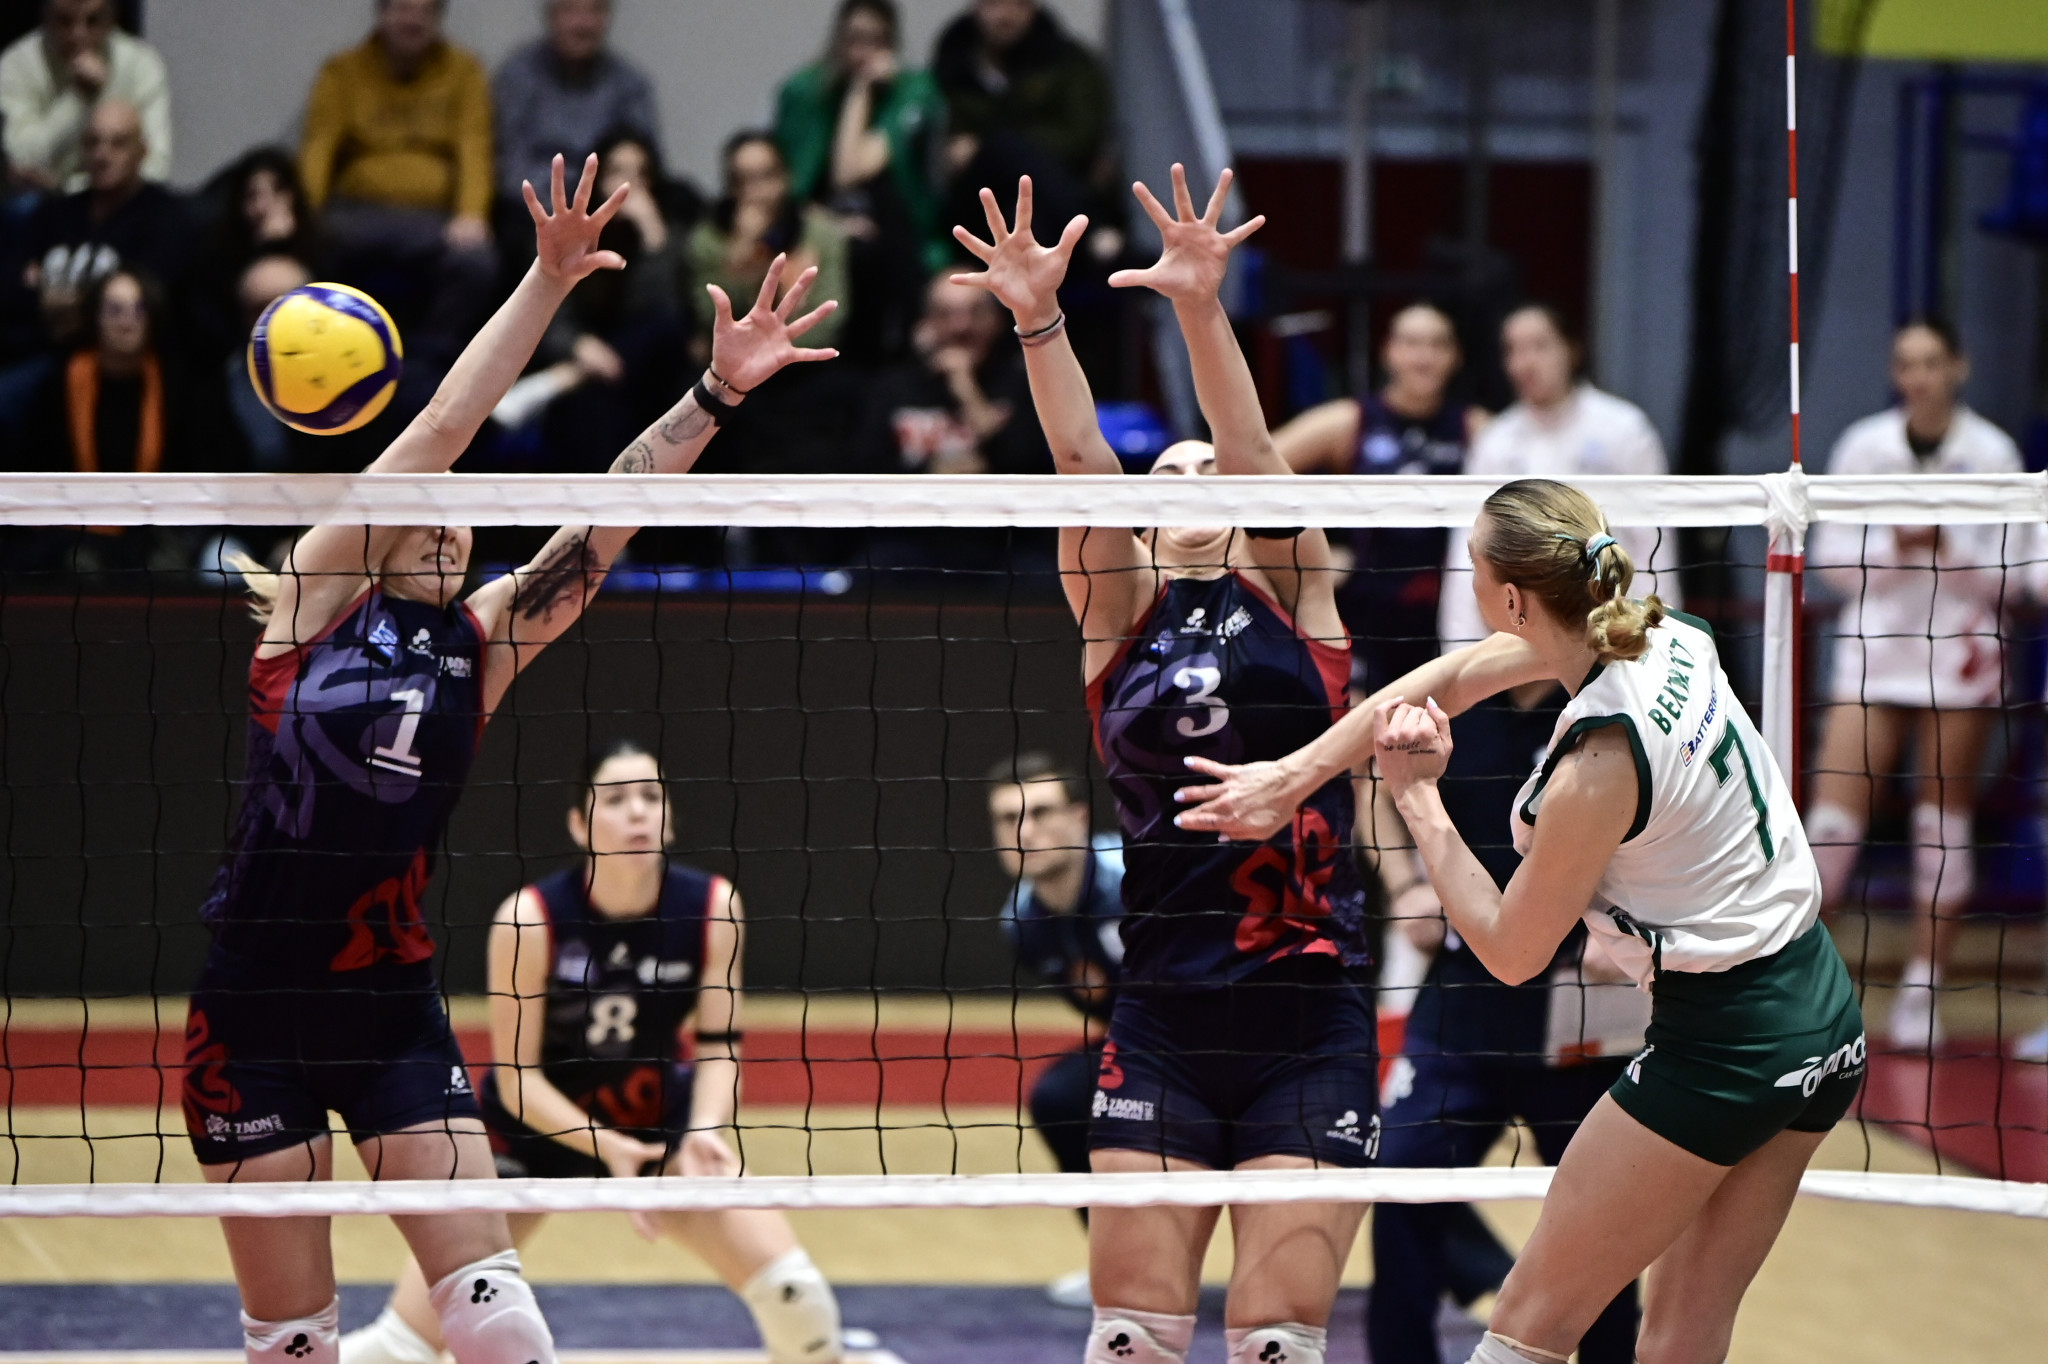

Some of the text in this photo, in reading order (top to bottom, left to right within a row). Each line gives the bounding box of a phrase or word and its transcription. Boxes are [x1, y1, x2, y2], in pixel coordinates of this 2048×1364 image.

[373, 688, 425, 766] 1
[1174, 666, 1230, 737] 3
[1707, 714, 1776, 867] 7
[586, 994, 638, 1045] 8
